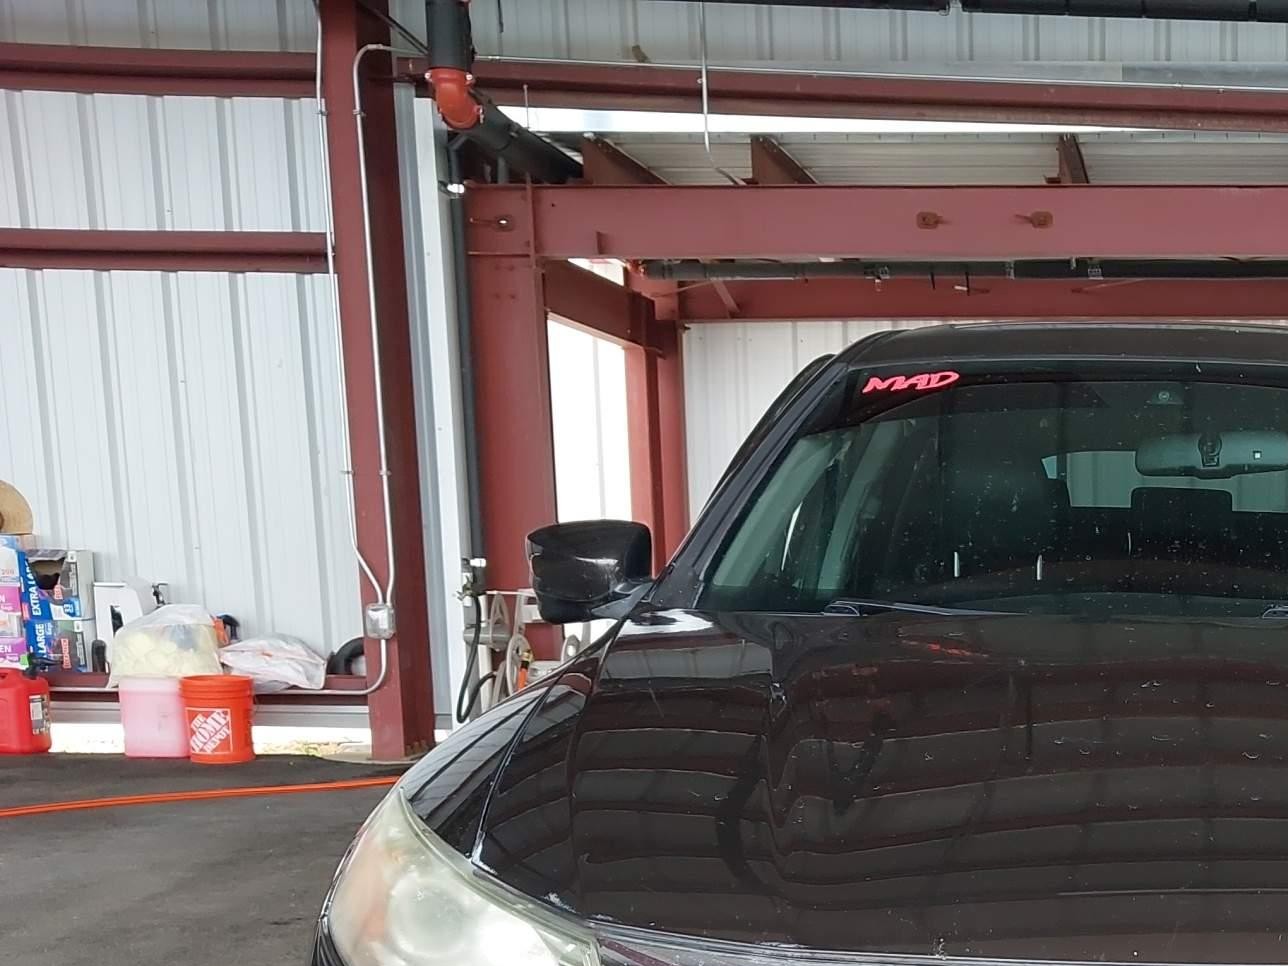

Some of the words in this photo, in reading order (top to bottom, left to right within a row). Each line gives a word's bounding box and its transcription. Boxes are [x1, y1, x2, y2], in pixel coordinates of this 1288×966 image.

[862, 371, 960, 394] MAD
[29, 586, 42, 616] EXTRA
[35, 623, 46, 654] LARGE
[190, 711, 228, 752] HOME
[191, 713, 206, 731] THE
[203, 727, 230, 752] DEPOT
